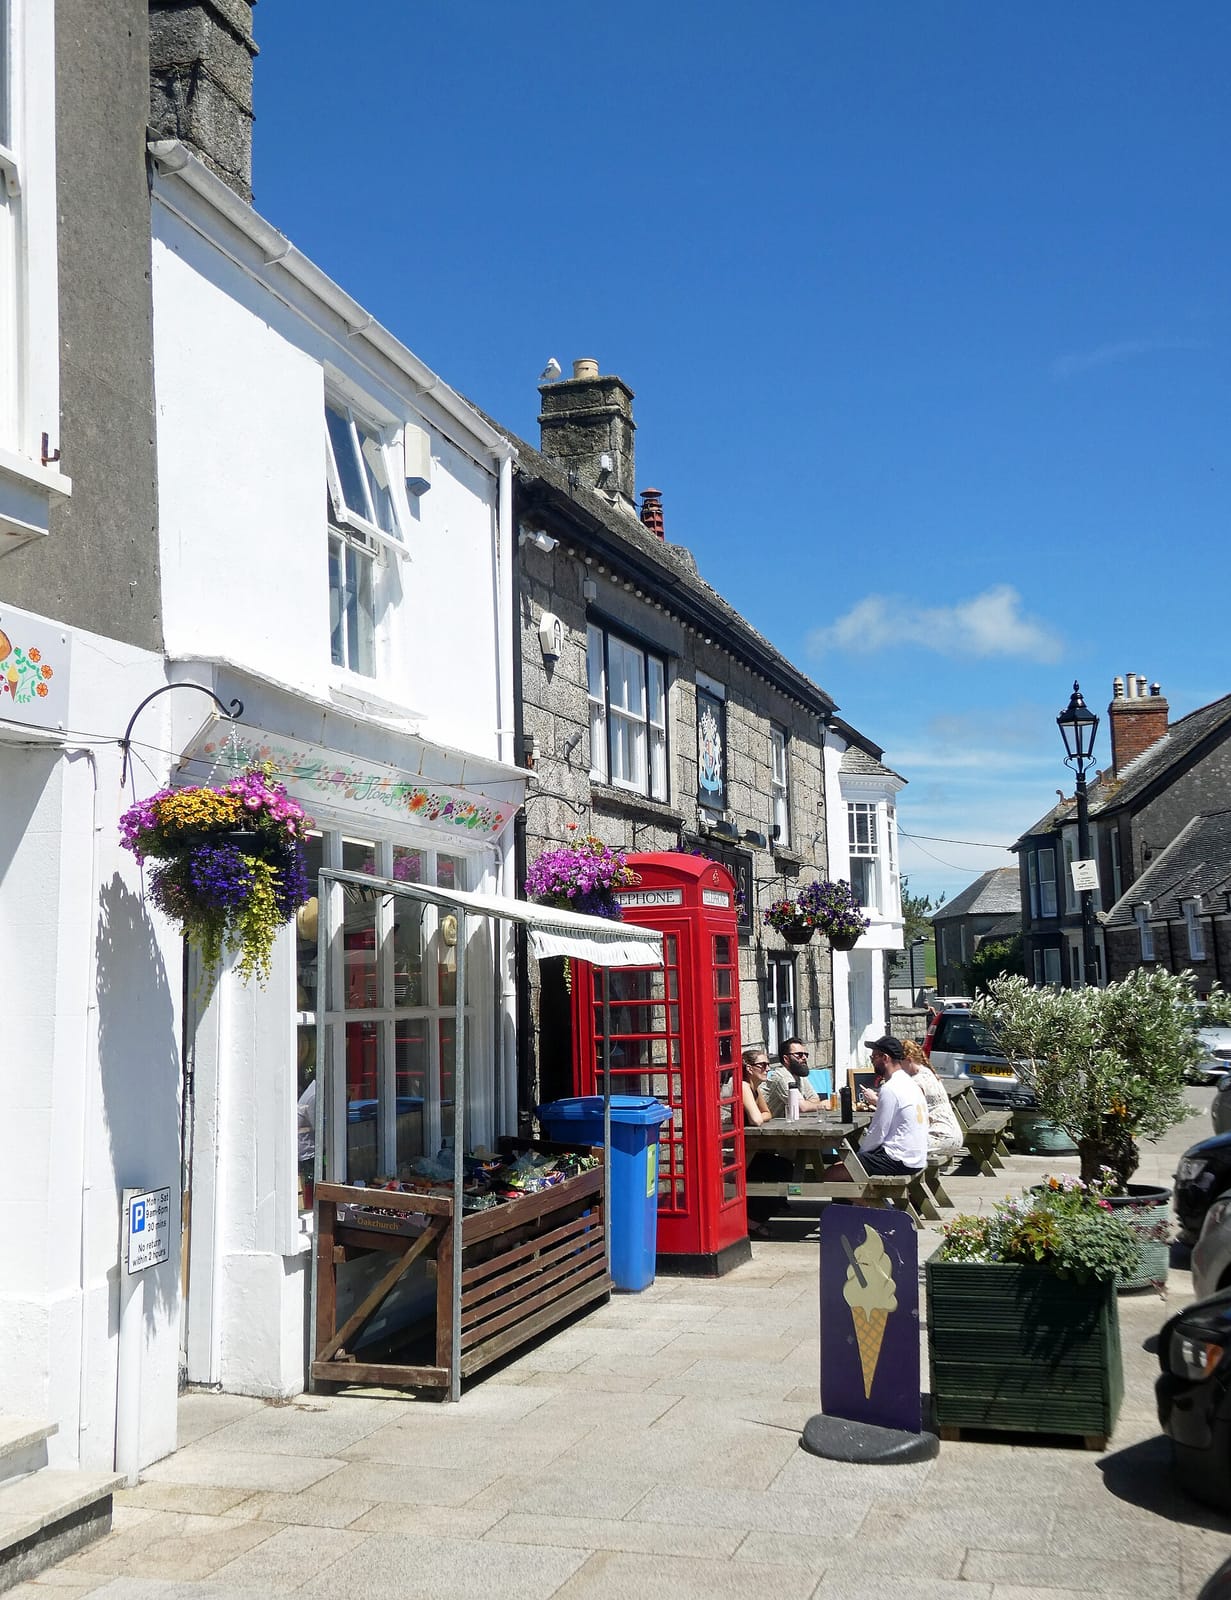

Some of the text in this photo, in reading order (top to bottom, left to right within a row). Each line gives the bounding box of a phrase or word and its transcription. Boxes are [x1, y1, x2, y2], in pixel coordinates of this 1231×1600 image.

[618, 891, 675, 905] EPHONE
[160, 1192, 169, 1203] Sat
[135, 1205, 144, 1231] P
[147, 1222, 155, 1233] 30
[138, 1238, 161, 1253] No return
[132, 1248, 166, 1267] within 2 hours
